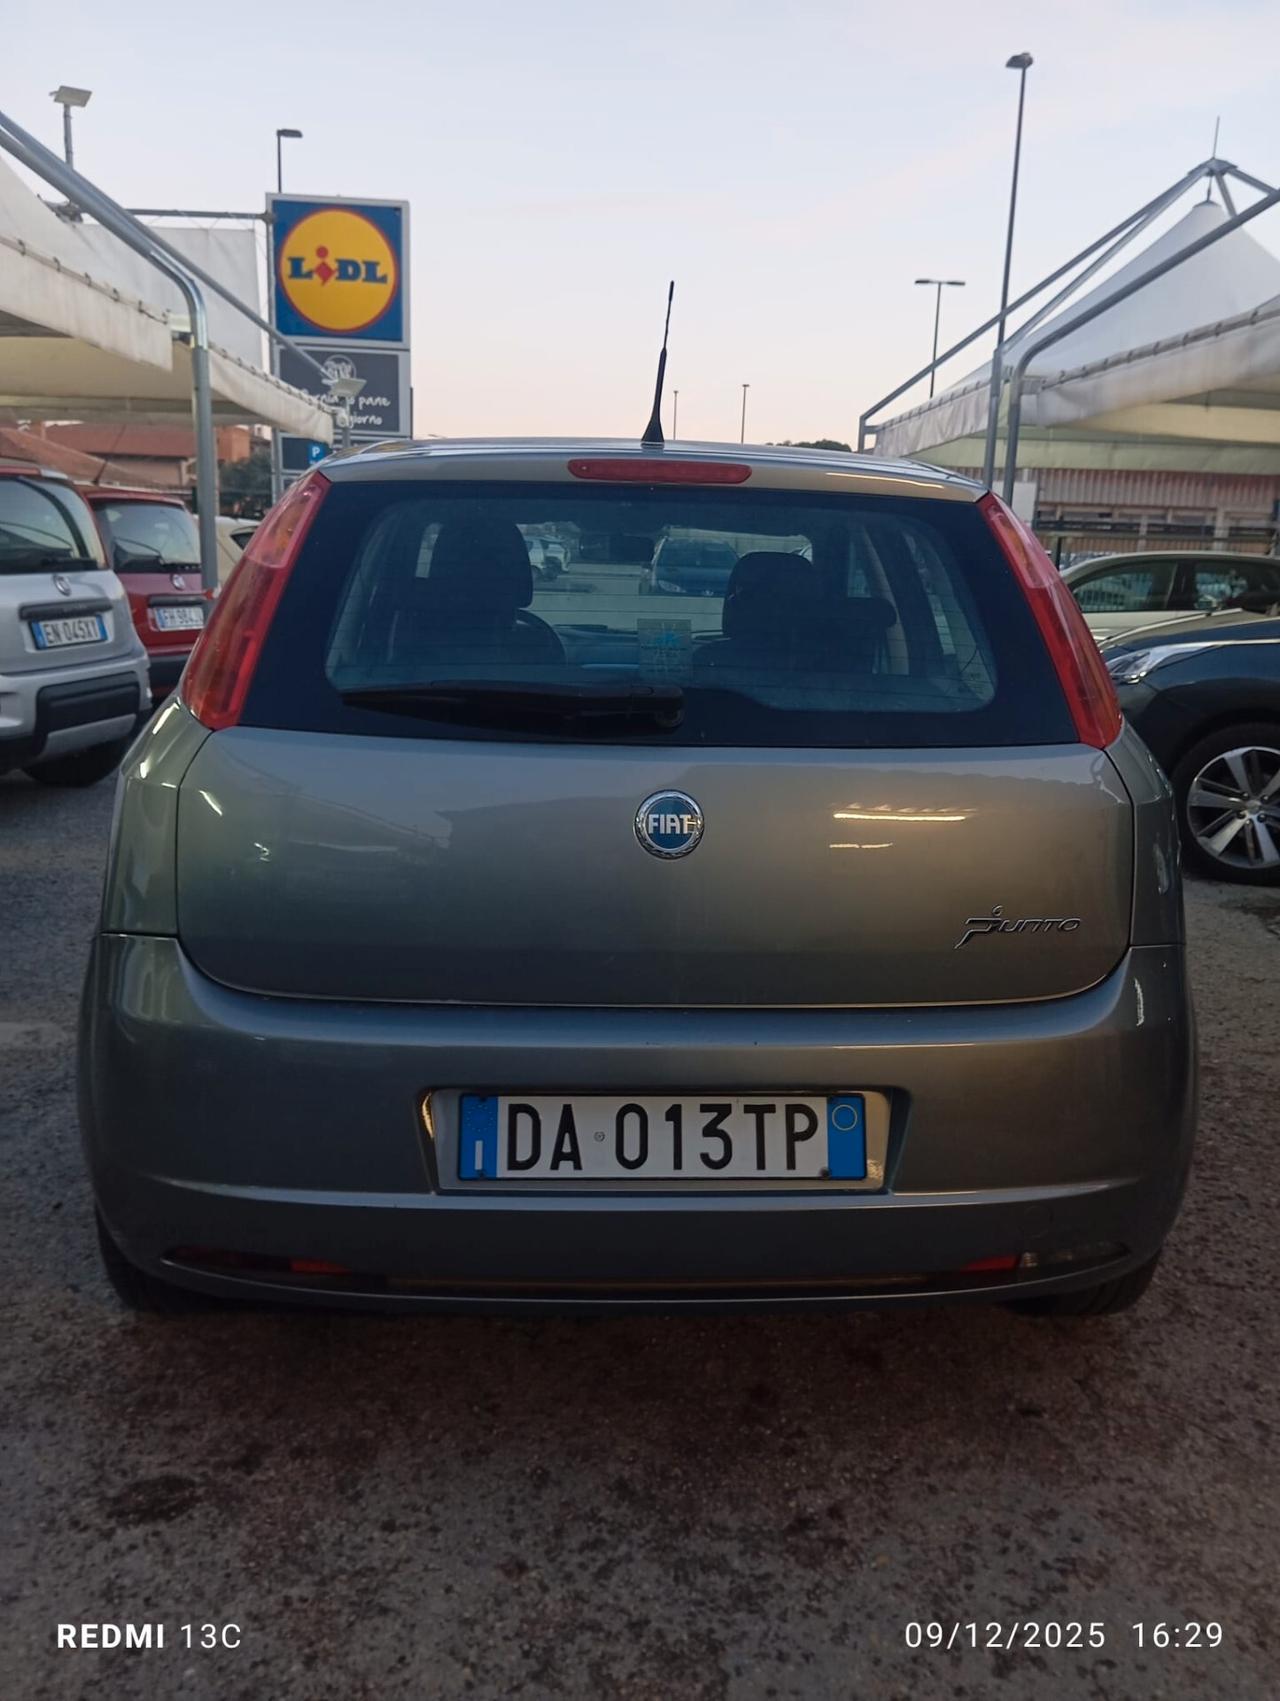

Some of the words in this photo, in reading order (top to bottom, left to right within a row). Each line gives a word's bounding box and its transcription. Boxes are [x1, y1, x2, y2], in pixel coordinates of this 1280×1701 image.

[358, 396, 391, 410] pane
[311, 446, 321, 458] P
[43, 622, 62, 644] EN
[648, 813, 692, 835] FIAT
[507, 1103, 583, 1171] DA
[615, 1102, 819, 1171] 013TP
[474, 1140, 483, 1170] I
